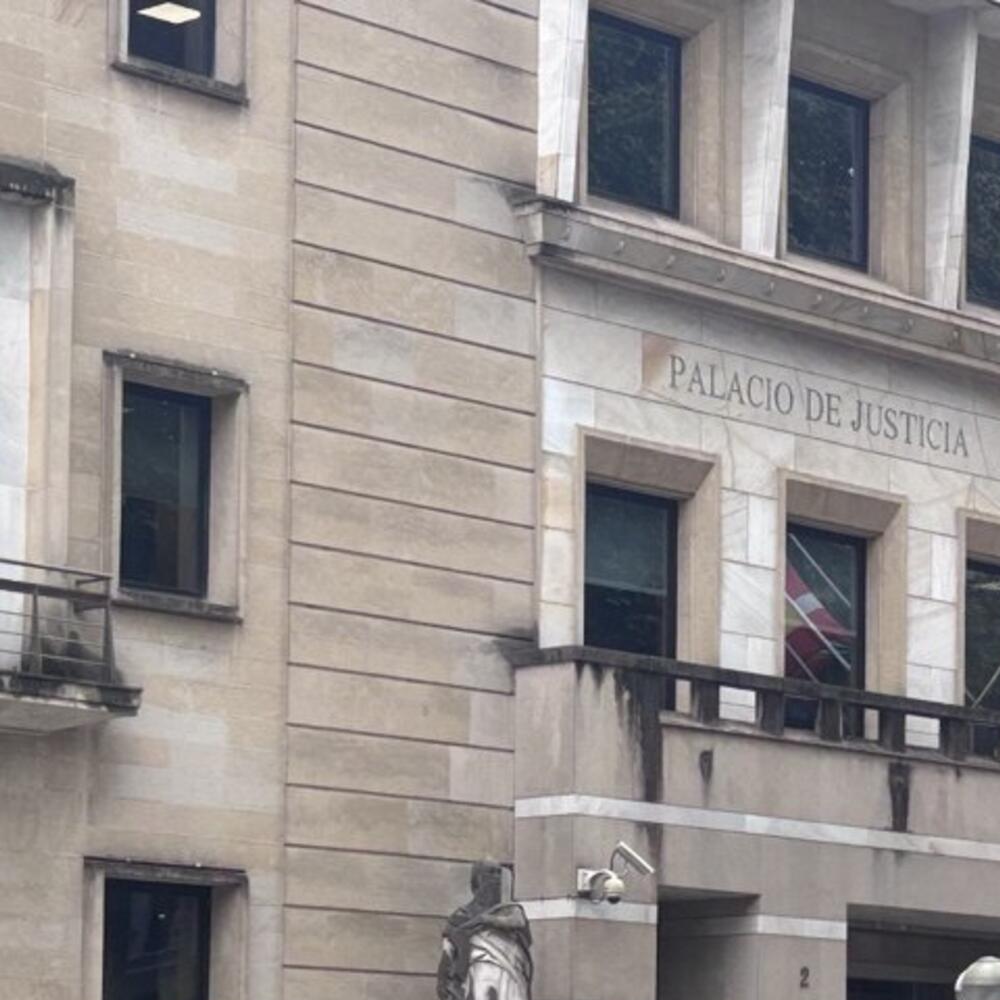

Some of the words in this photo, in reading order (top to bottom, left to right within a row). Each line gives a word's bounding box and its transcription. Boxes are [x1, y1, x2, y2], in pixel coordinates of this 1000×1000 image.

[669, 354, 795, 415] PALACIO
[805, 387, 841, 427] DE
[851, 399, 969, 458] JUSTICIA
[800, 966, 810, 989] 2
